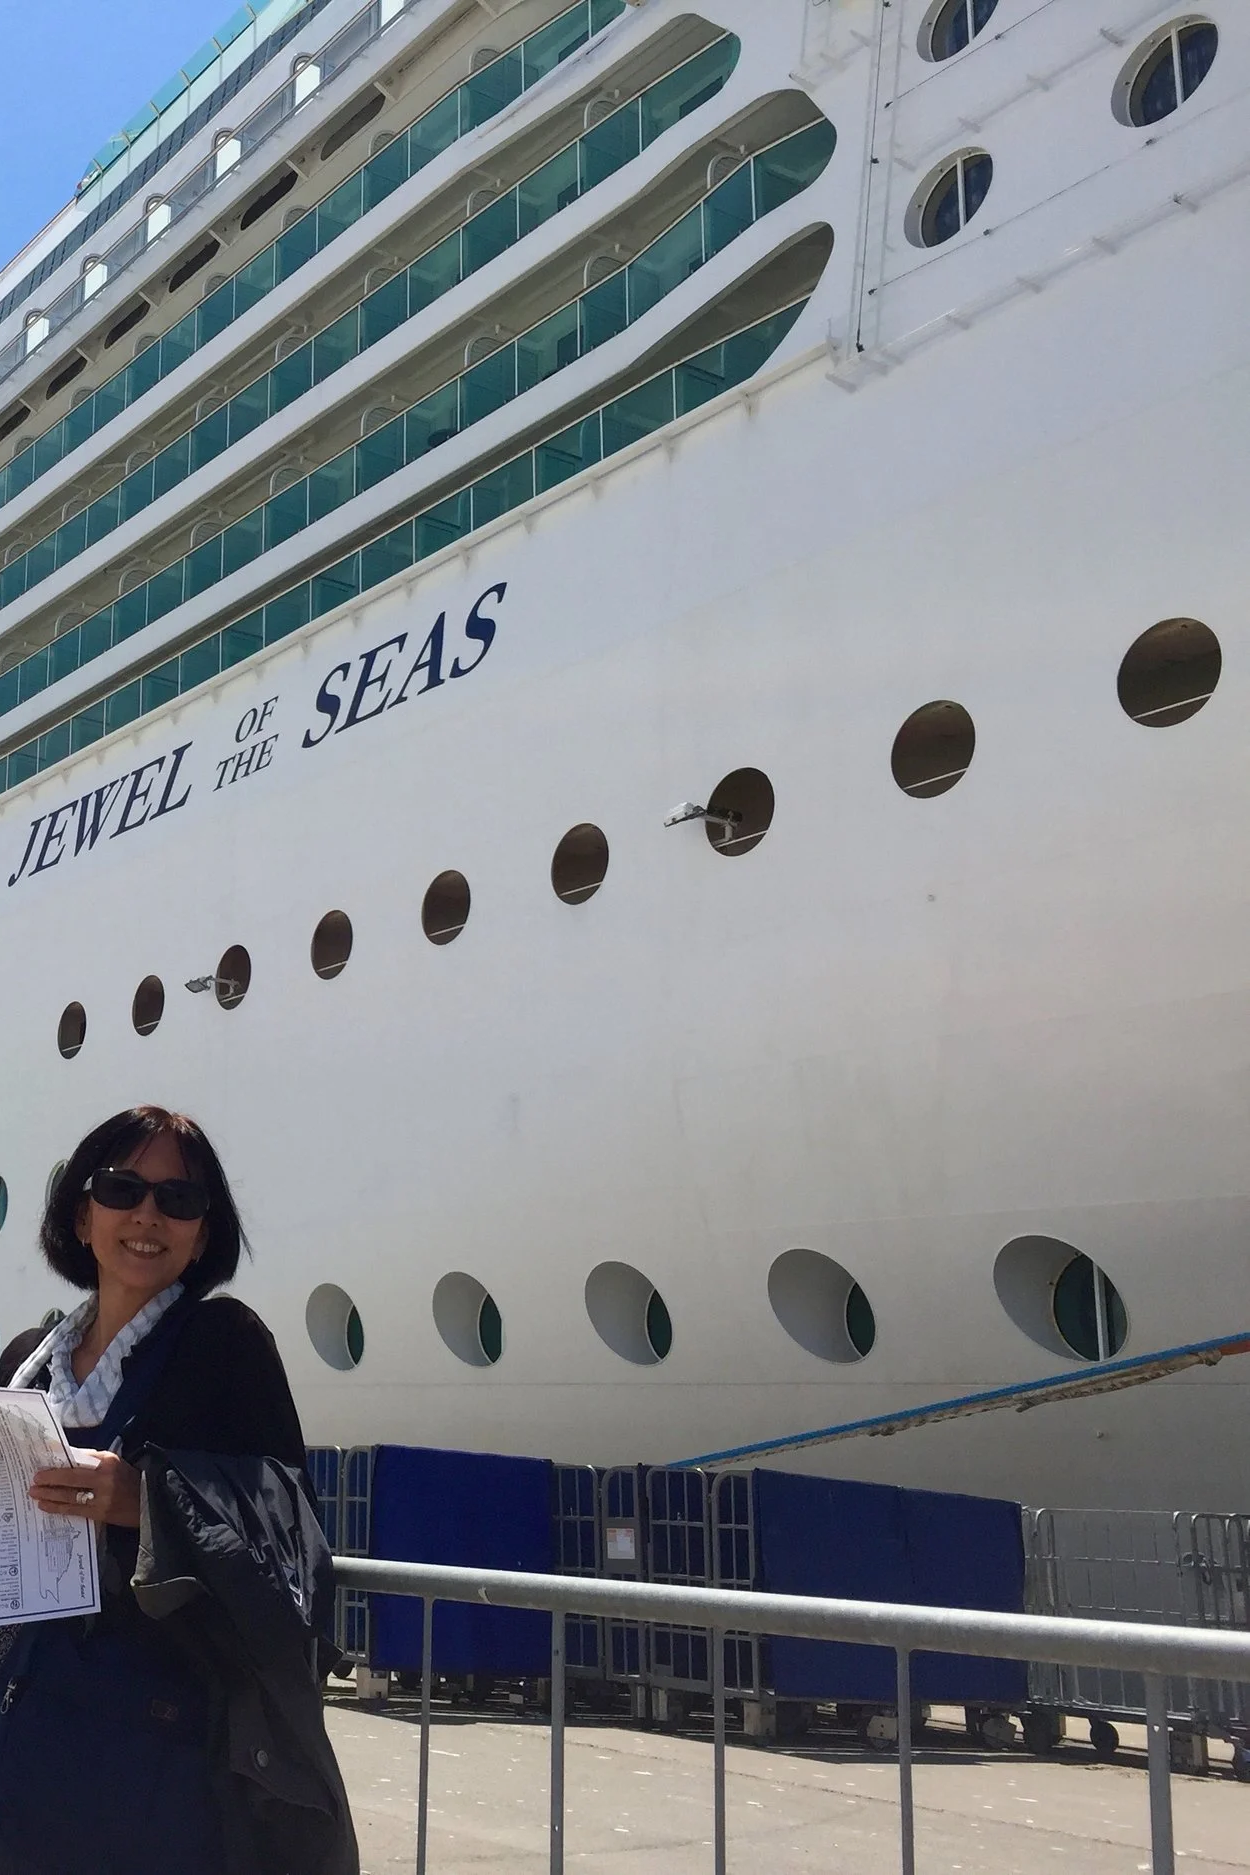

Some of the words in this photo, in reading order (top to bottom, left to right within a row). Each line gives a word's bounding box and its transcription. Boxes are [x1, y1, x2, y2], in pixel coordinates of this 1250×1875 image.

[301, 582, 507, 748] SEAS
[213, 734, 279, 792] THE
[235, 696, 279, 743] OF
[7, 740, 193, 887] JEWEL
